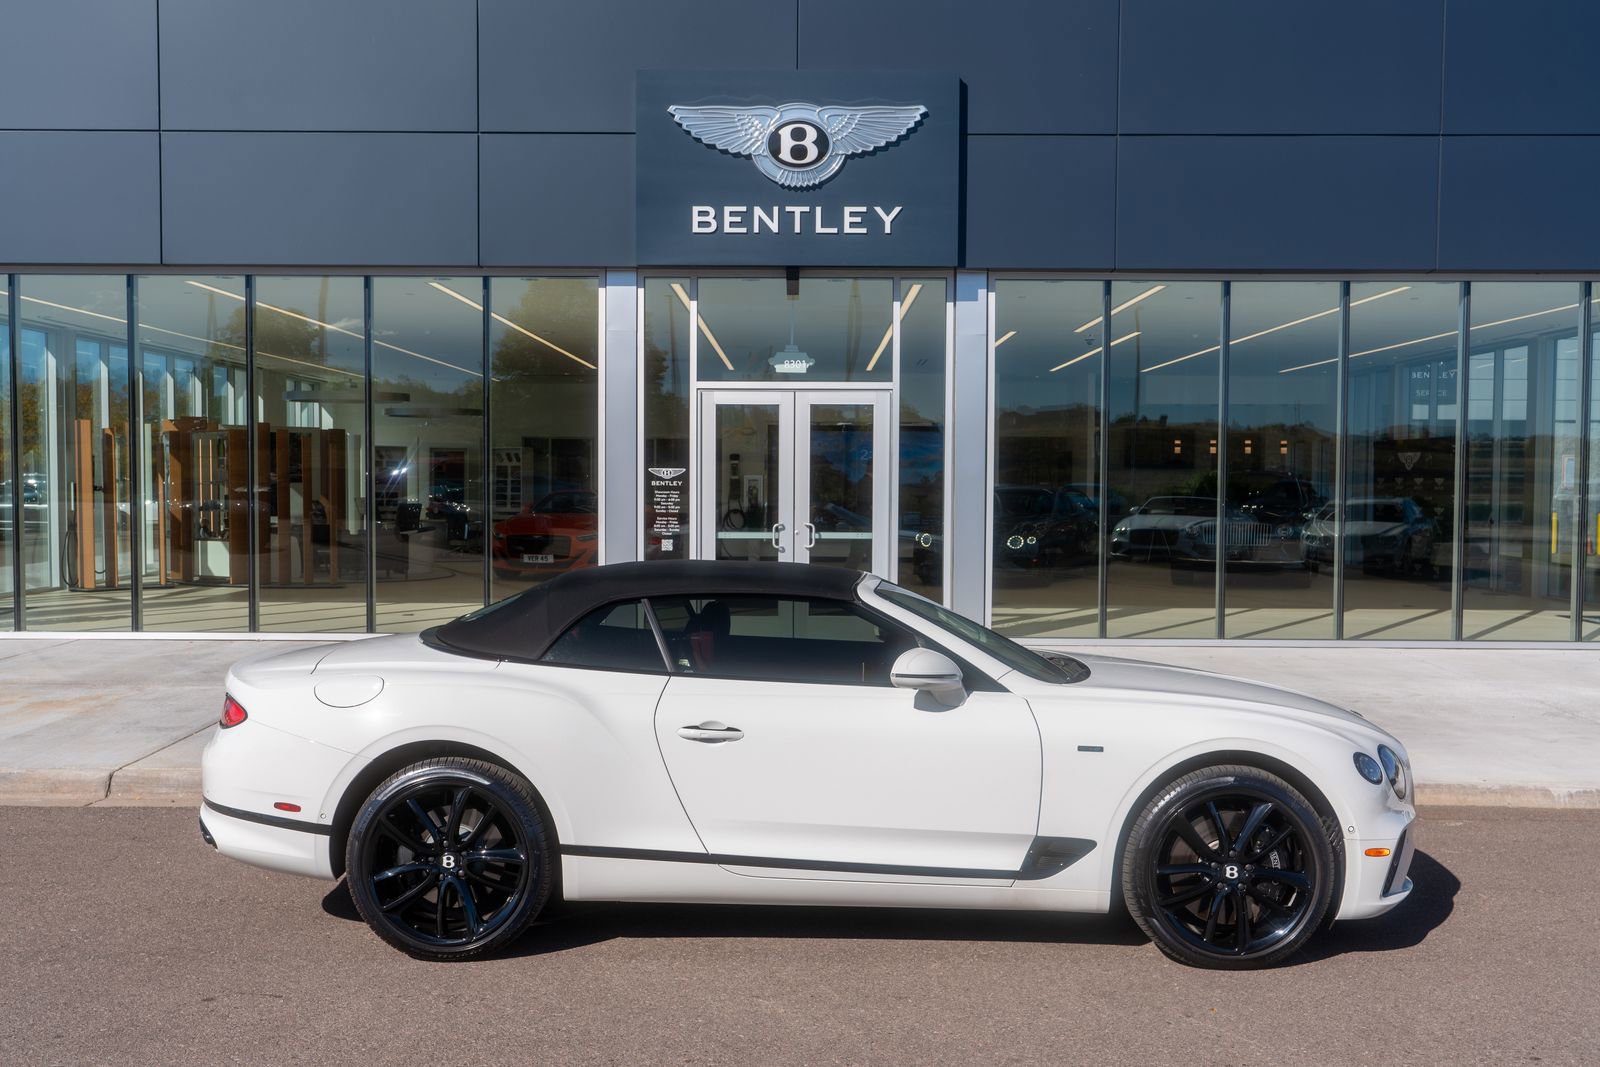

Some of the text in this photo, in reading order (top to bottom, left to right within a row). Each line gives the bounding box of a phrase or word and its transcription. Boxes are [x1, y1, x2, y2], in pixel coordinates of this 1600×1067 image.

[778, 123, 819, 165] B
[691, 205, 903, 234] BENTLEY
[442, 855, 455, 868] B
[1225, 865, 1239, 879] B
